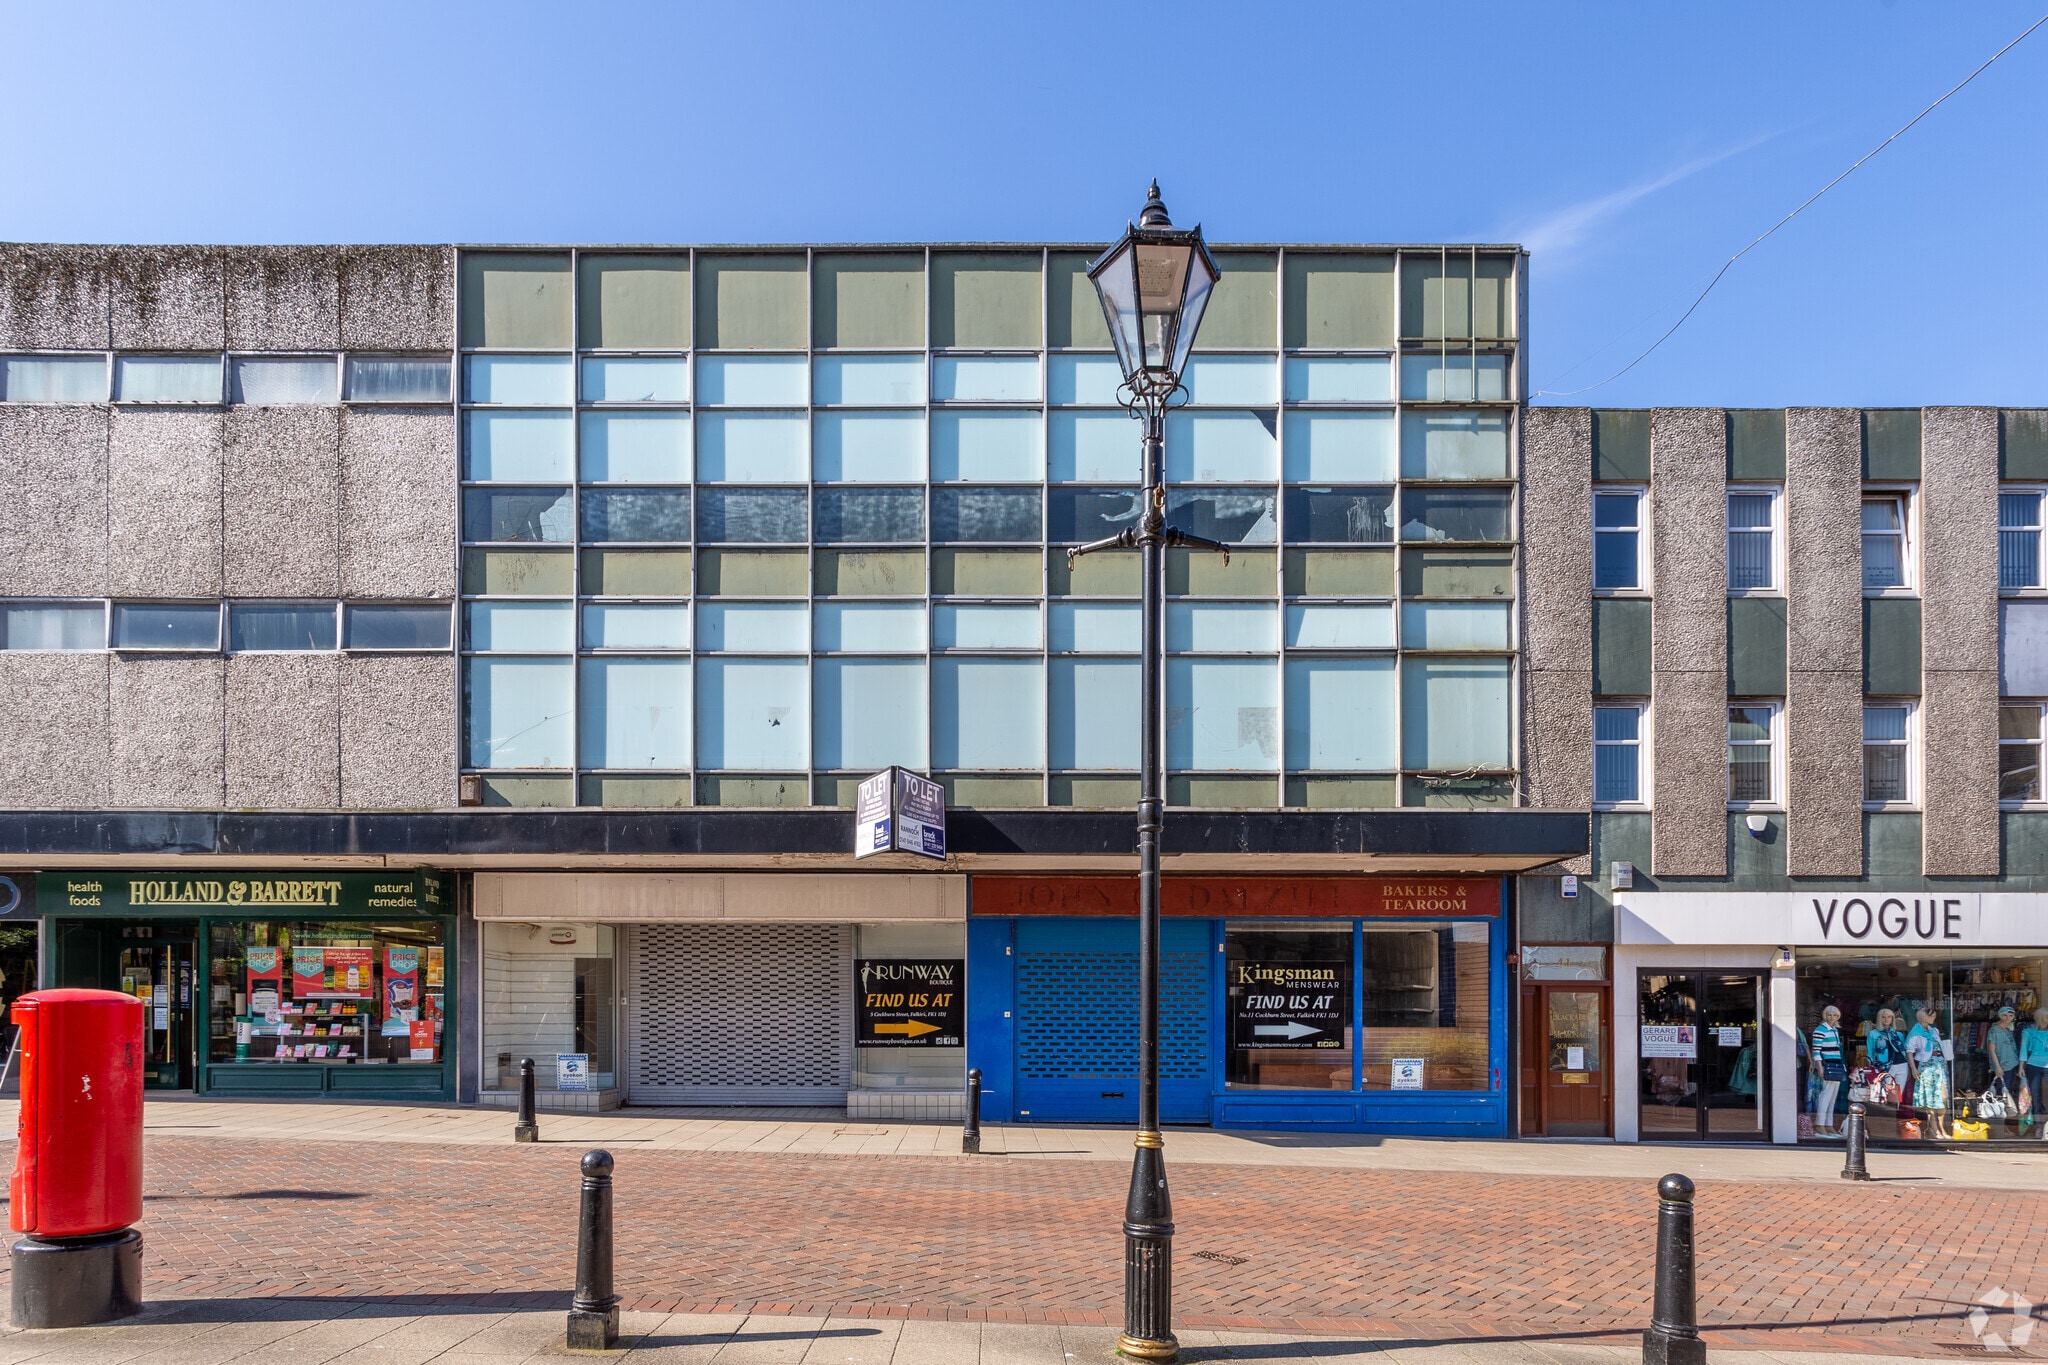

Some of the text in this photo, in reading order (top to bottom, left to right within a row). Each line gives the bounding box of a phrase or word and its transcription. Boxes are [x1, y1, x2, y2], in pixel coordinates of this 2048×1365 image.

[861, 774, 888, 802] TO LET
[903, 774, 940, 803] TO LET
[68, 881, 102, 893] health
[129, 880, 342, 906] HOLLAND & BARRETT
[374, 882, 413, 893] natural
[1382, 885, 1467, 897] BAKERS &
[69, 895, 101, 906] foods
[368, 896, 417, 907] remedies
[1382, 899, 1467, 911] TEAROOM
[1812, 898, 1961, 940] VOGUE
[296, 955, 320, 964] PRICE
[392, 953, 416, 961] PRICE
[250, 960, 273, 968] DROP
[296, 963, 320, 972] DROP
[876, 965, 954, 980] RUNWAY
[1238, 963, 1335, 986] Kingsman
[865, 993, 953, 1007] FIND US AT
[1246, 995, 1334, 1009] FIND US AT
